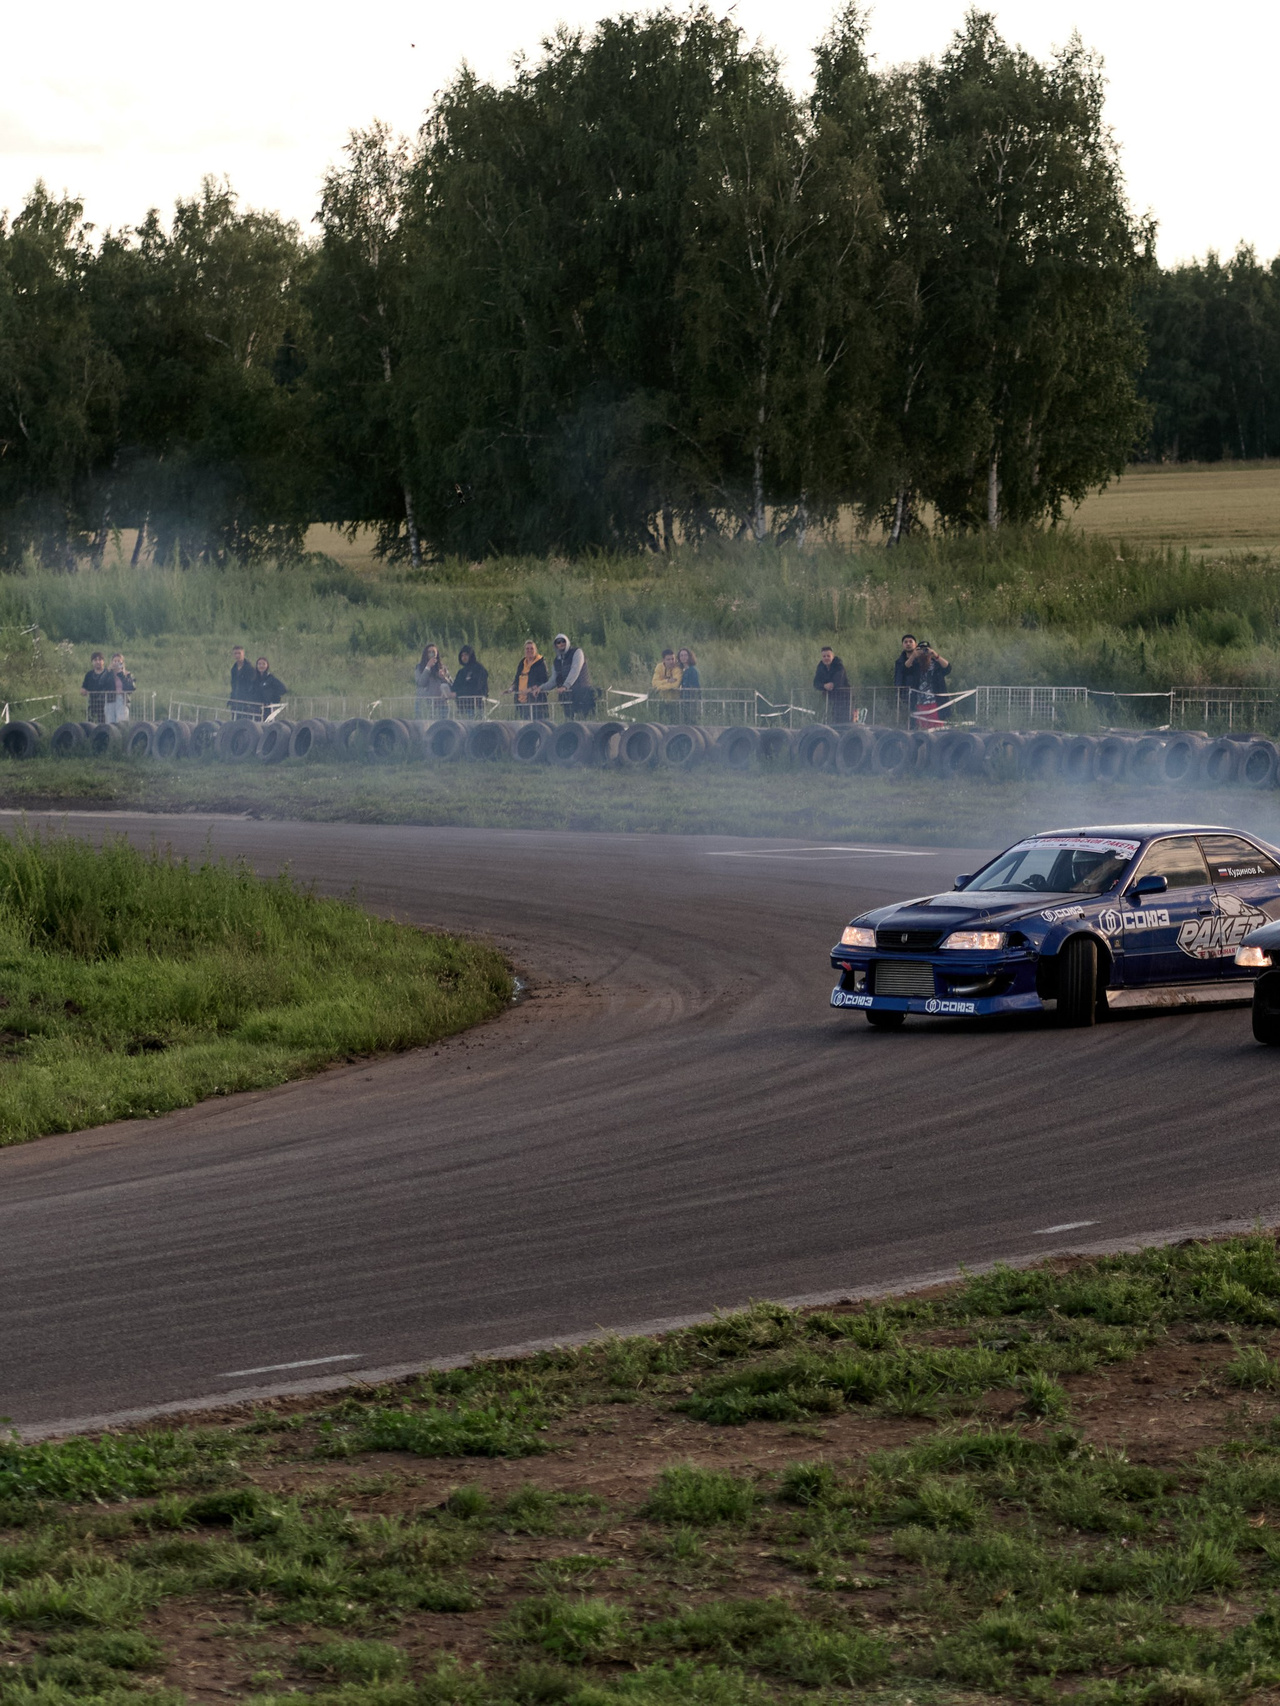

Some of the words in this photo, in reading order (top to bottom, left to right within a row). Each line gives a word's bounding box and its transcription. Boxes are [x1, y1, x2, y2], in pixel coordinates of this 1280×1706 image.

[1227, 867, 1257, 878] Кудинов
[1055, 905, 1084, 918] СОЮЗ
[1122, 909, 1170, 930] СОЮЗ
[1178, 916, 1271, 952] РАКЕТ
[845, 995, 873, 1007] СОЮЗ
[940, 1001, 975, 1013] СОЮЗ
